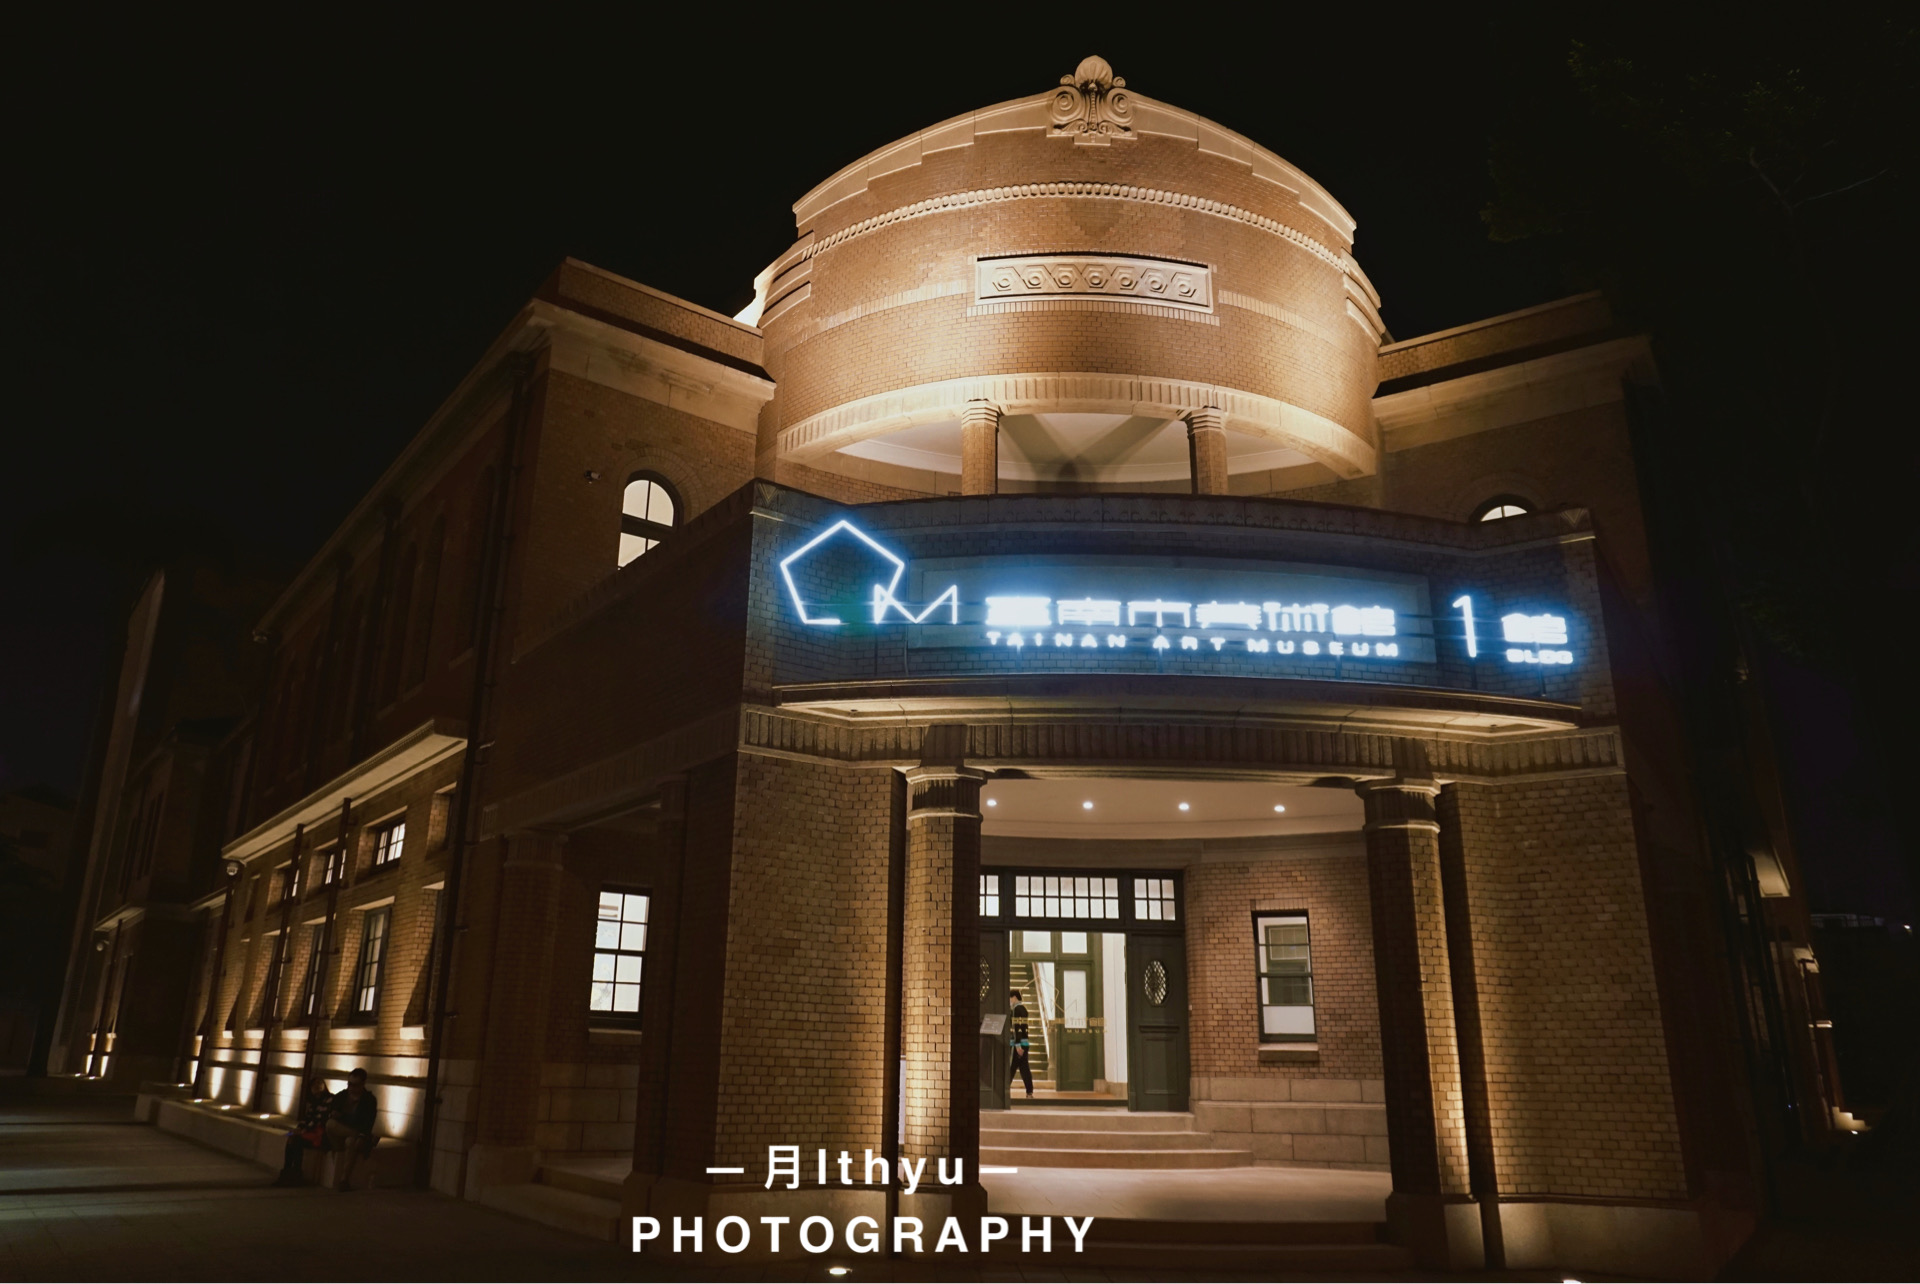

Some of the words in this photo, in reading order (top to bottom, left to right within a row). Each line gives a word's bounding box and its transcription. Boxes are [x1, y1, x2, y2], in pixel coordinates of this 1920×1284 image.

[986, 631, 1126, 648] TAINAN
[1152, 635, 1226, 651] ART
[1246, 638, 1399, 658] MUSEUM
